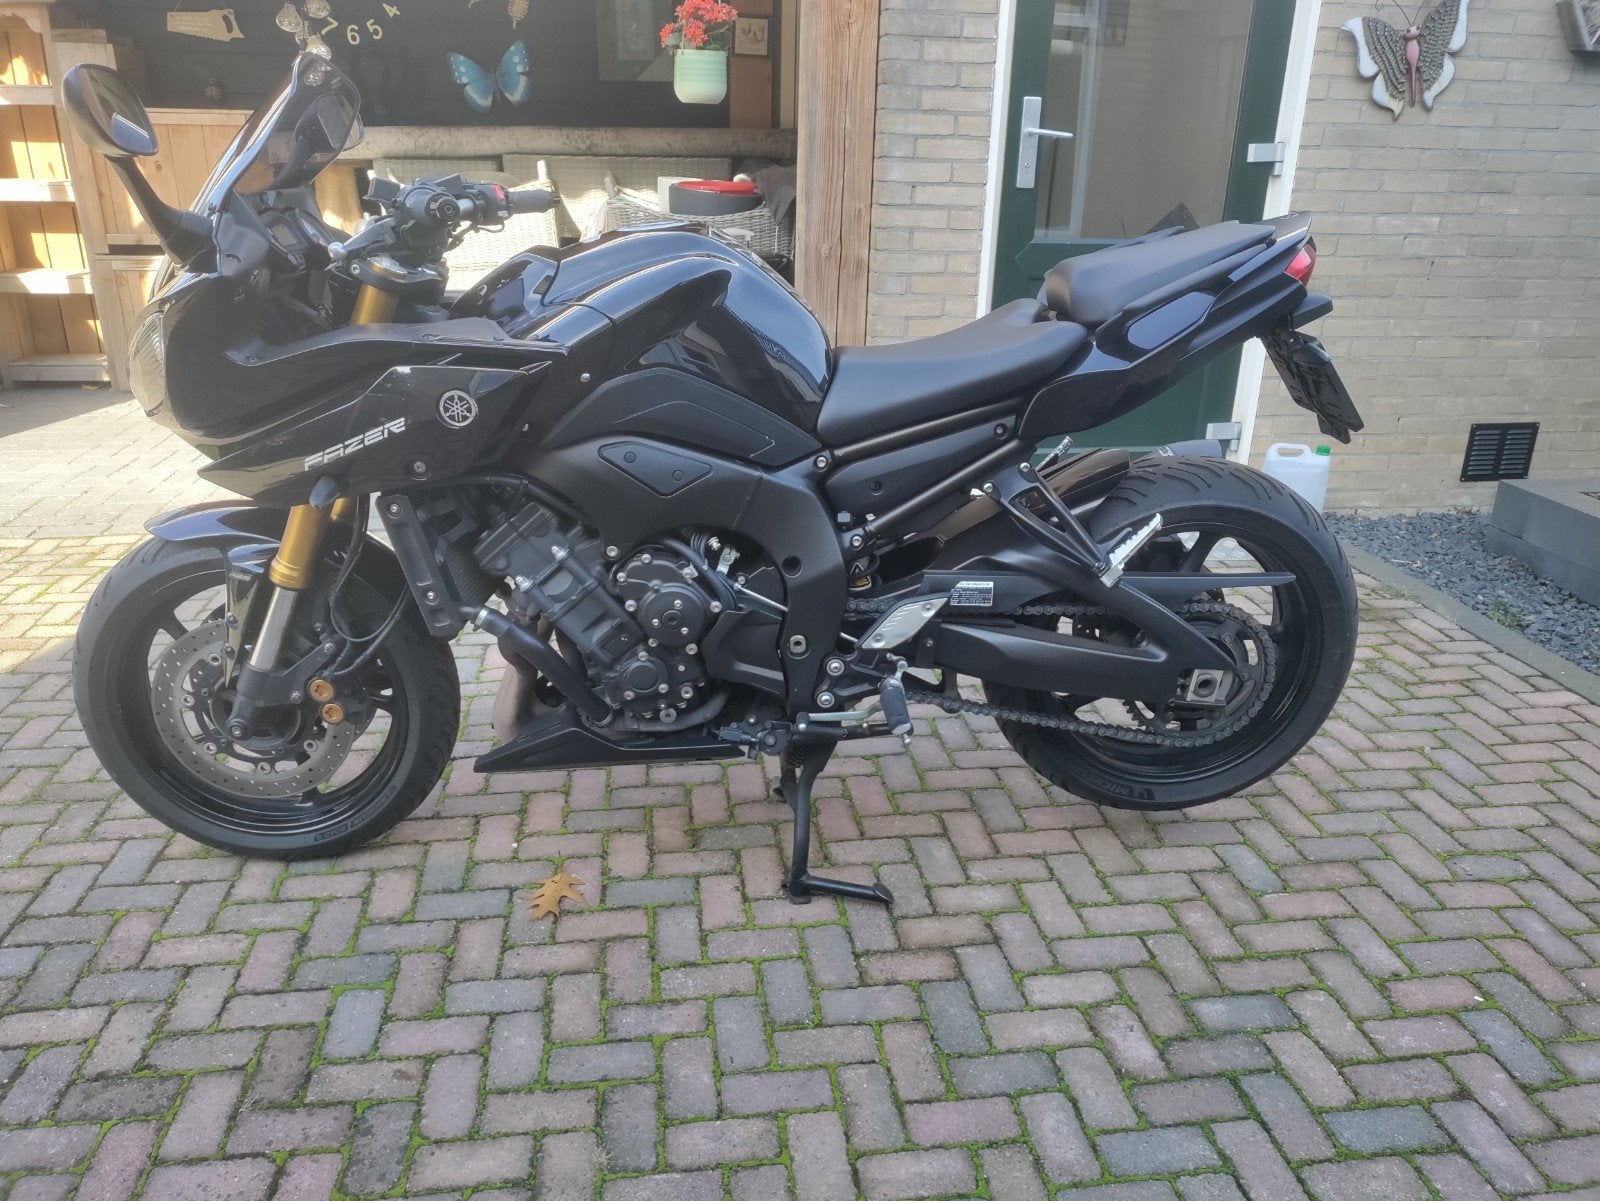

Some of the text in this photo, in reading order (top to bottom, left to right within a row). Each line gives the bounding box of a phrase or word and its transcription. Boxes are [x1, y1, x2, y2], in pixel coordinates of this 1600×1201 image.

[382, 2, 400, 18] 4
[320, 16, 339, 36] 7
[346, 24, 360, 45] 6
[366, 18, 383, 40] 5
[304, 417, 406, 472] FAZER
